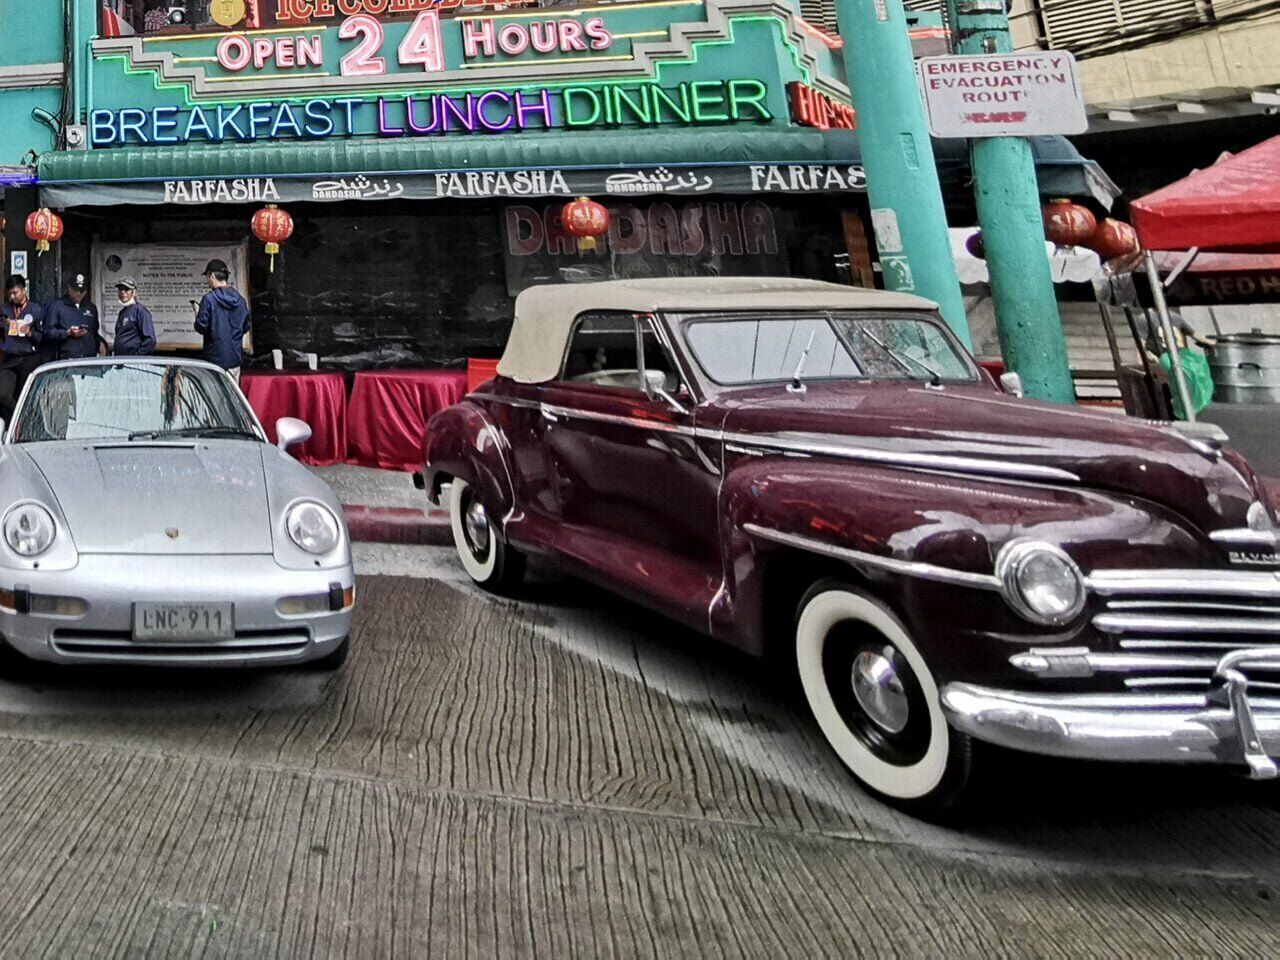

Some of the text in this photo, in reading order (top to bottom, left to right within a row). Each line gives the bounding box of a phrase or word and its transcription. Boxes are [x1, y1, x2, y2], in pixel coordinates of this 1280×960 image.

[216, 10, 614, 77] OPEN 24 HOURS
[962, 90, 1028, 103] ROUT
[89, 97, 365, 145] BREAKFAST
[376, 86, 554, 137] LUNCH
[563, 78, 775, 129] DINNER
[163, 177, 281, 202] FARFASHA
[434, 170, 572, 197] FARFASHA
[505, 200, 778, 257] DADASHA
[142, 609, 222, 629] LNC 911
